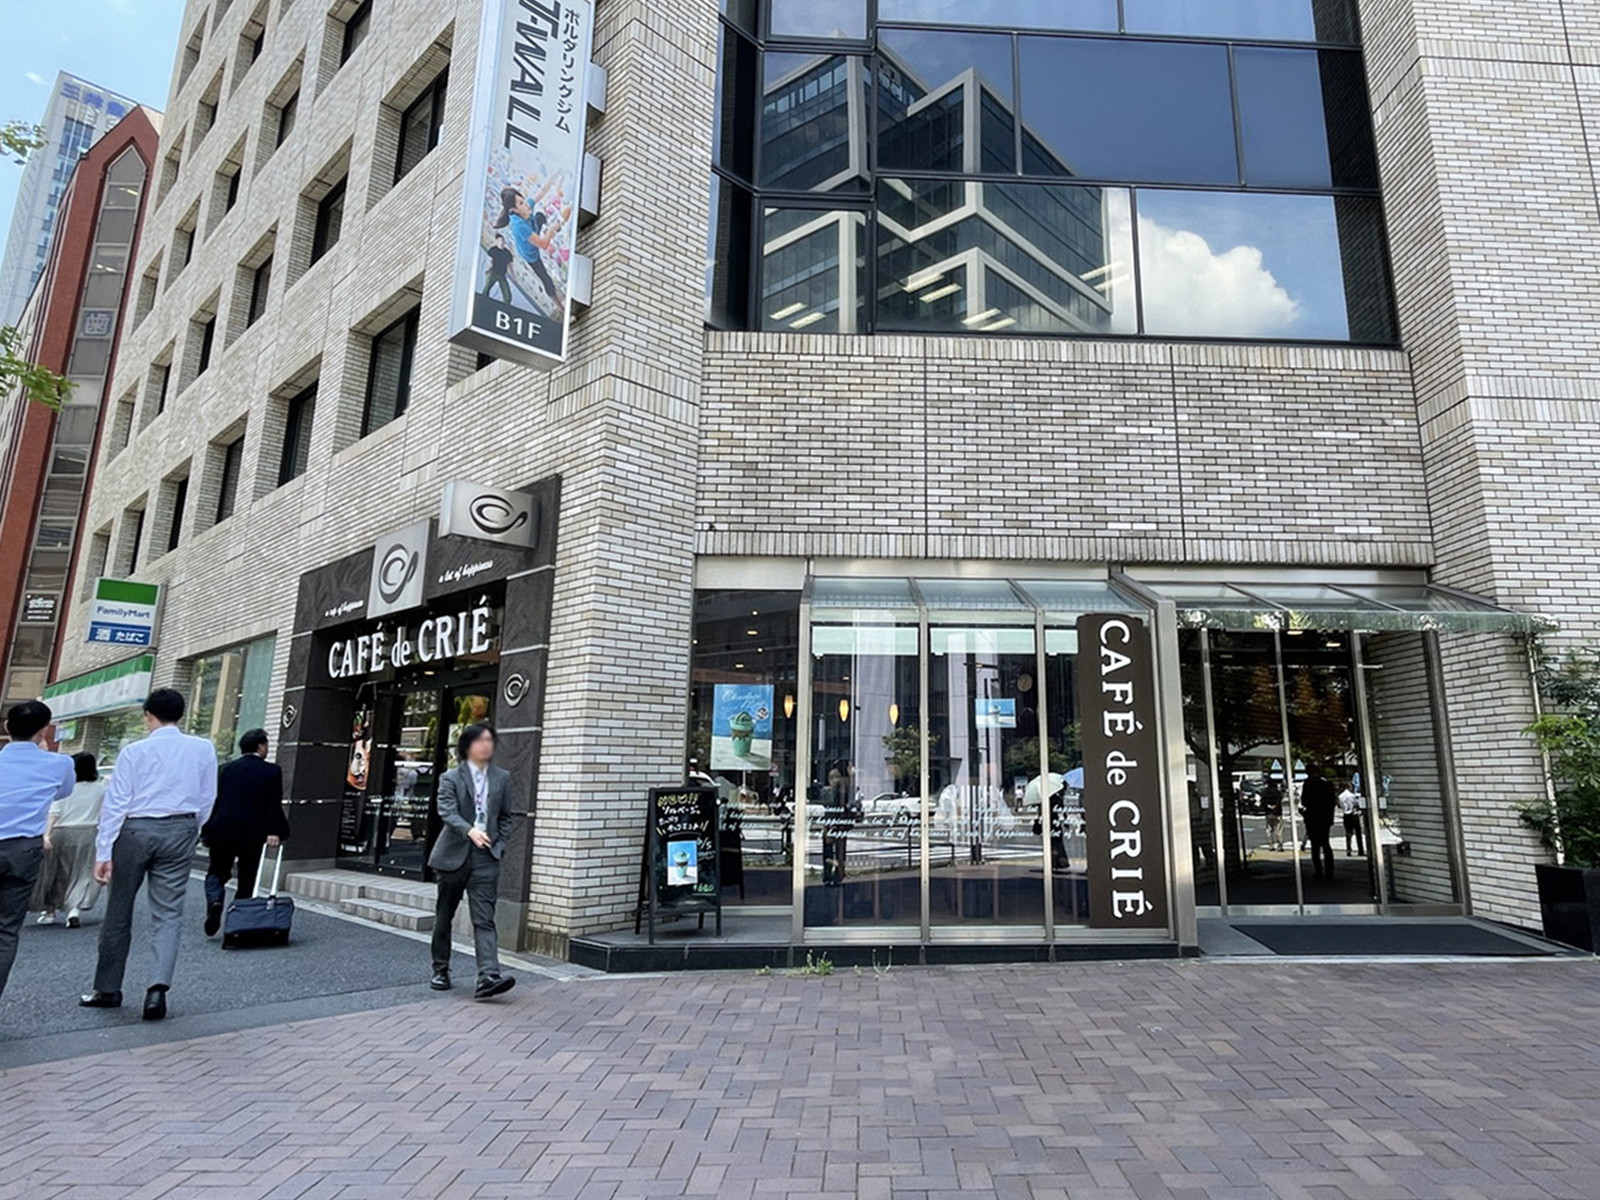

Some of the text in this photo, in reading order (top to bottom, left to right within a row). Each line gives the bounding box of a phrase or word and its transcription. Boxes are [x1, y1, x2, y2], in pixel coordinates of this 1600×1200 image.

[555, 8, 581, 134] ボルダリングジム
[85, 313, 111, 334] 歯
[495, 310, 542, 340] B1F
[97, 606, 151, 619] FamilyMart
[95, 628, 145, 643] 酒 たばこ
[328, 594, 490, 679] CAFÉ de CRIÉ
[1100, 619, 1154, 919] CAFÉ de CRIÉ
[816, 815, 857, 826] happiness
[872, 816, 883, 824] lot
[886, 815, 895, 827] of
[827, 826, 867, 839] happiness
[883, 828, 895, 837] lot
[897, 828, 907, 840] of
[995, 828, 1035, 838] happiness
